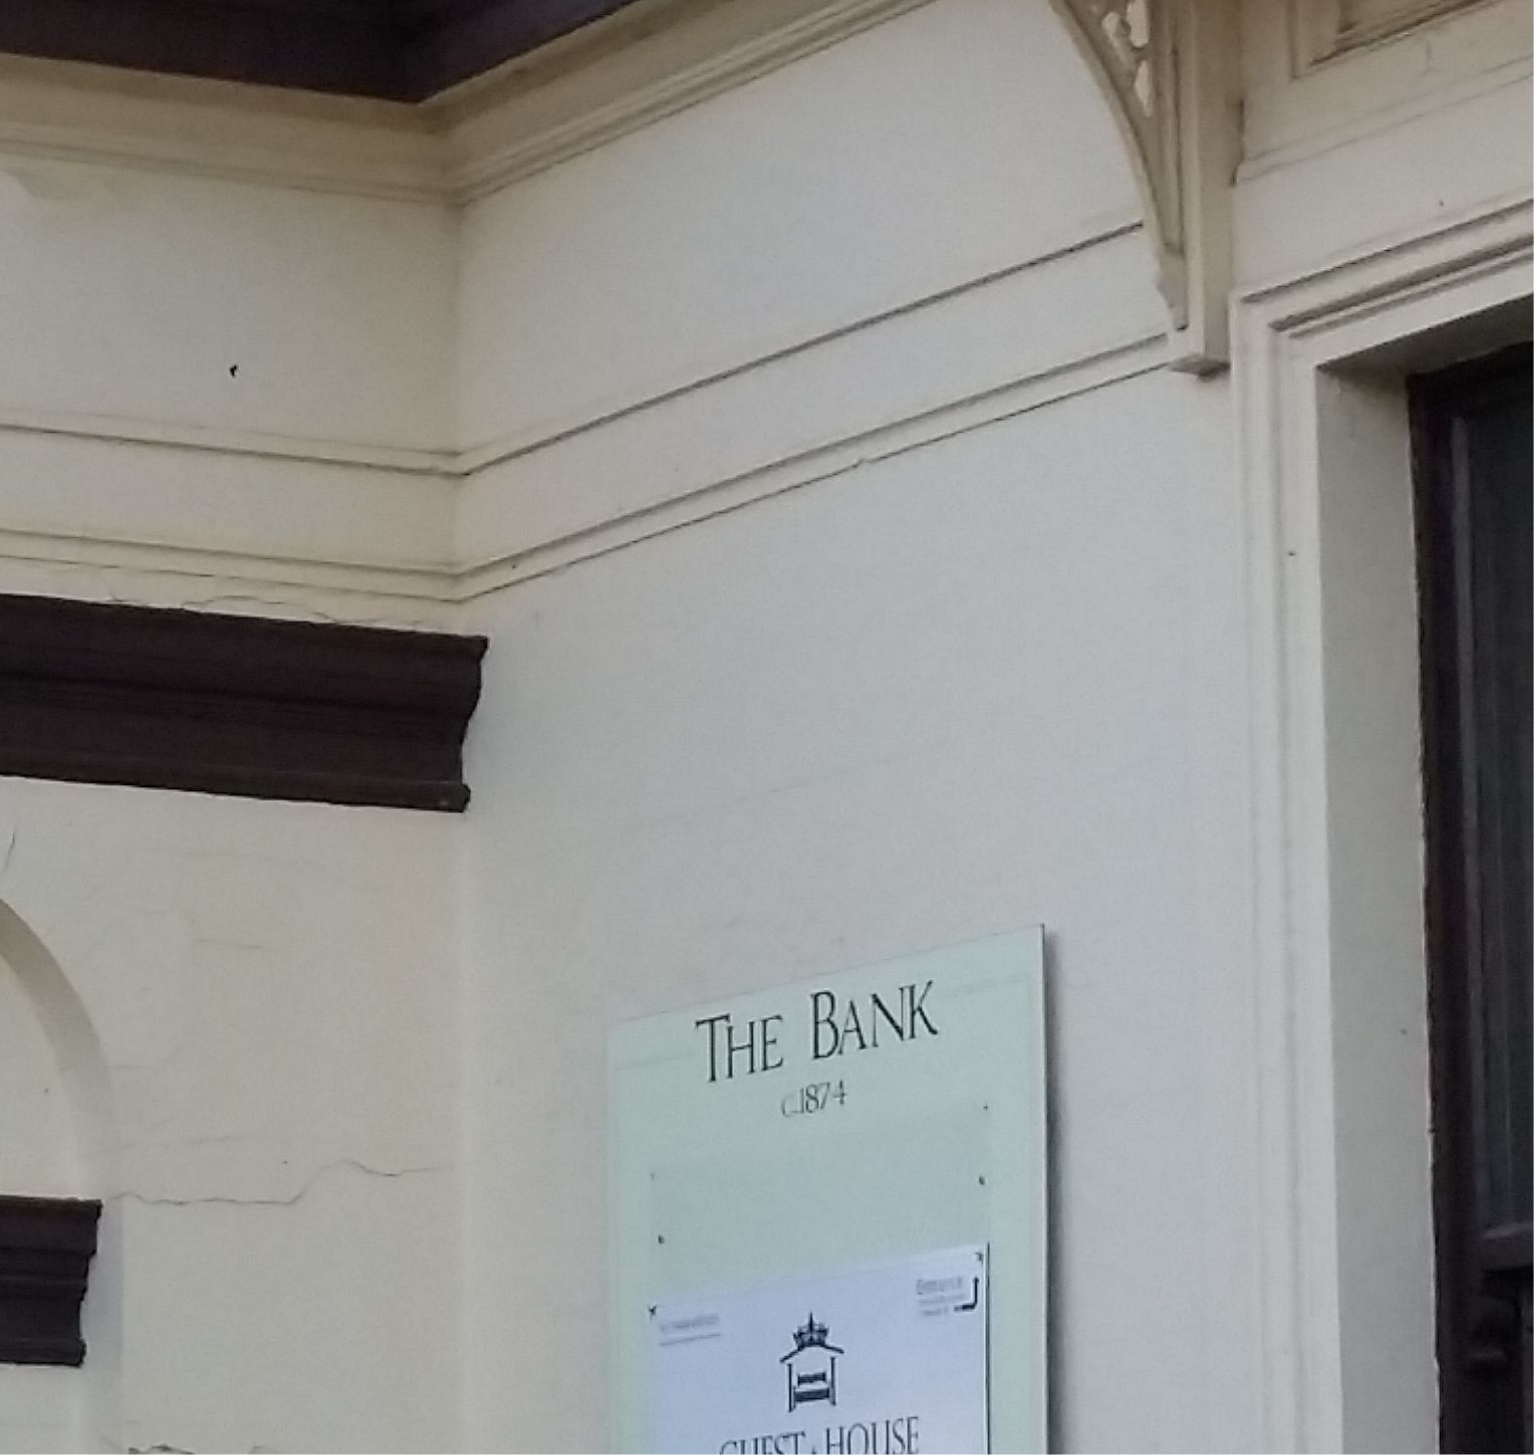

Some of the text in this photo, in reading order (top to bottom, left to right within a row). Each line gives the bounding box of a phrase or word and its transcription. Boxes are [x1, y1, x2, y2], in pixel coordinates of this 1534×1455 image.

[695, 979, 939, 1083] THE BANK
[826, 1416, 919, 1455] HOUSE
